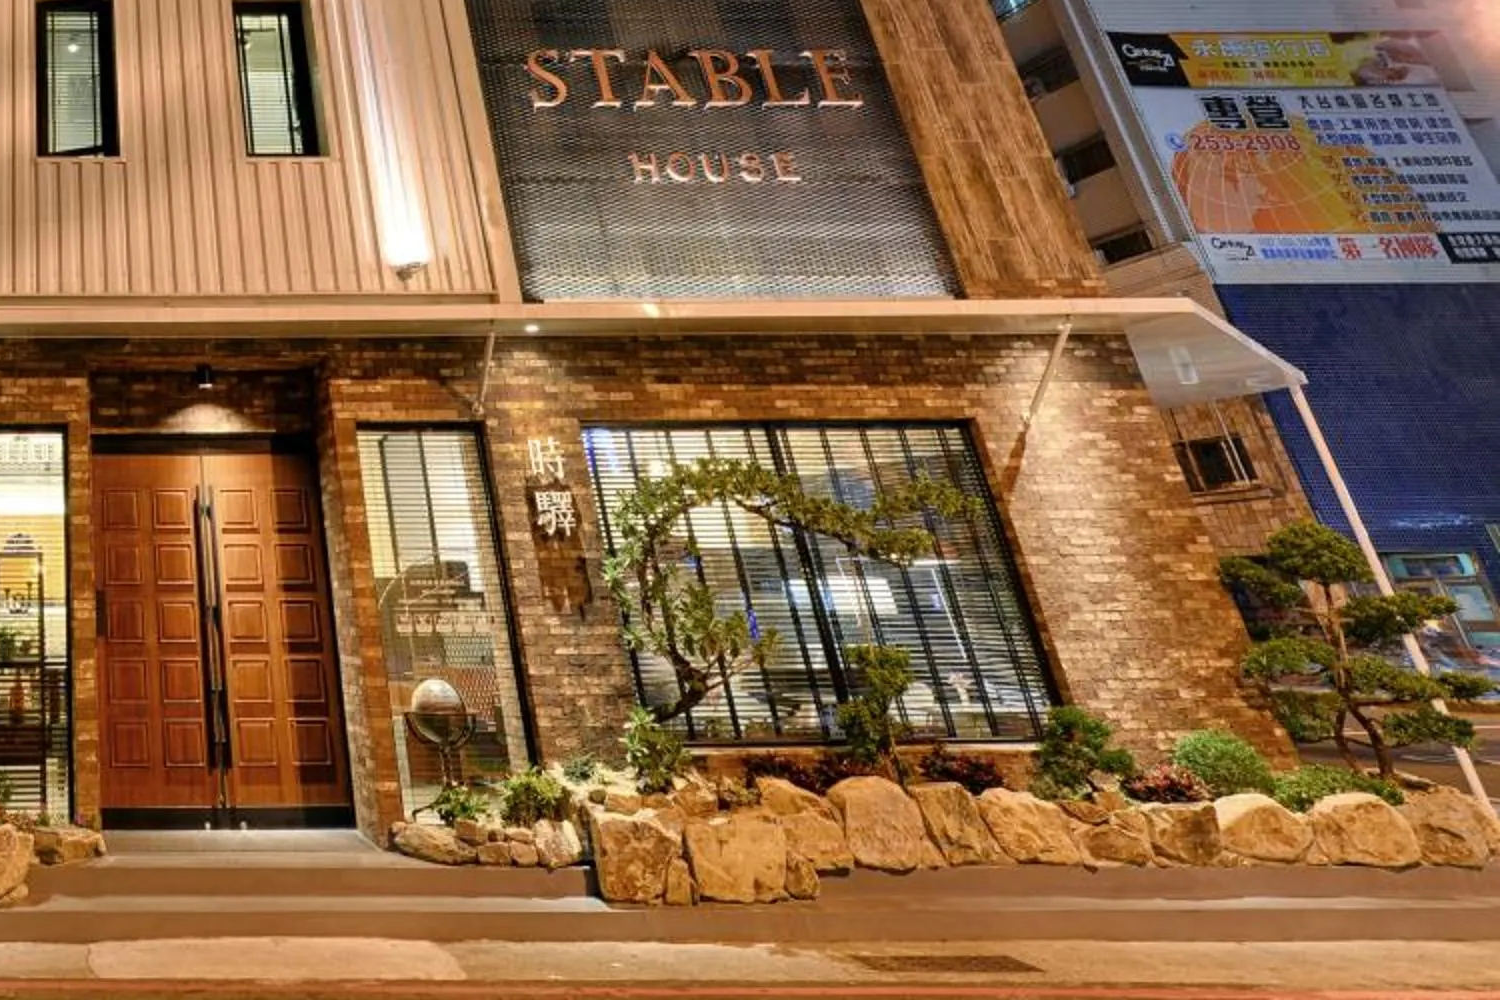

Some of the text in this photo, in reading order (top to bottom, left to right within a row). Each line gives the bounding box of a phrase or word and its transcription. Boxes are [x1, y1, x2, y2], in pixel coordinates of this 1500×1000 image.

[524, 48, 865, 112] STABLE
[1188, 133, 1302, 151] 253-2908
[628, 152, 802, 184] HOUSE
[528, 437, 577, 537] 時驛
